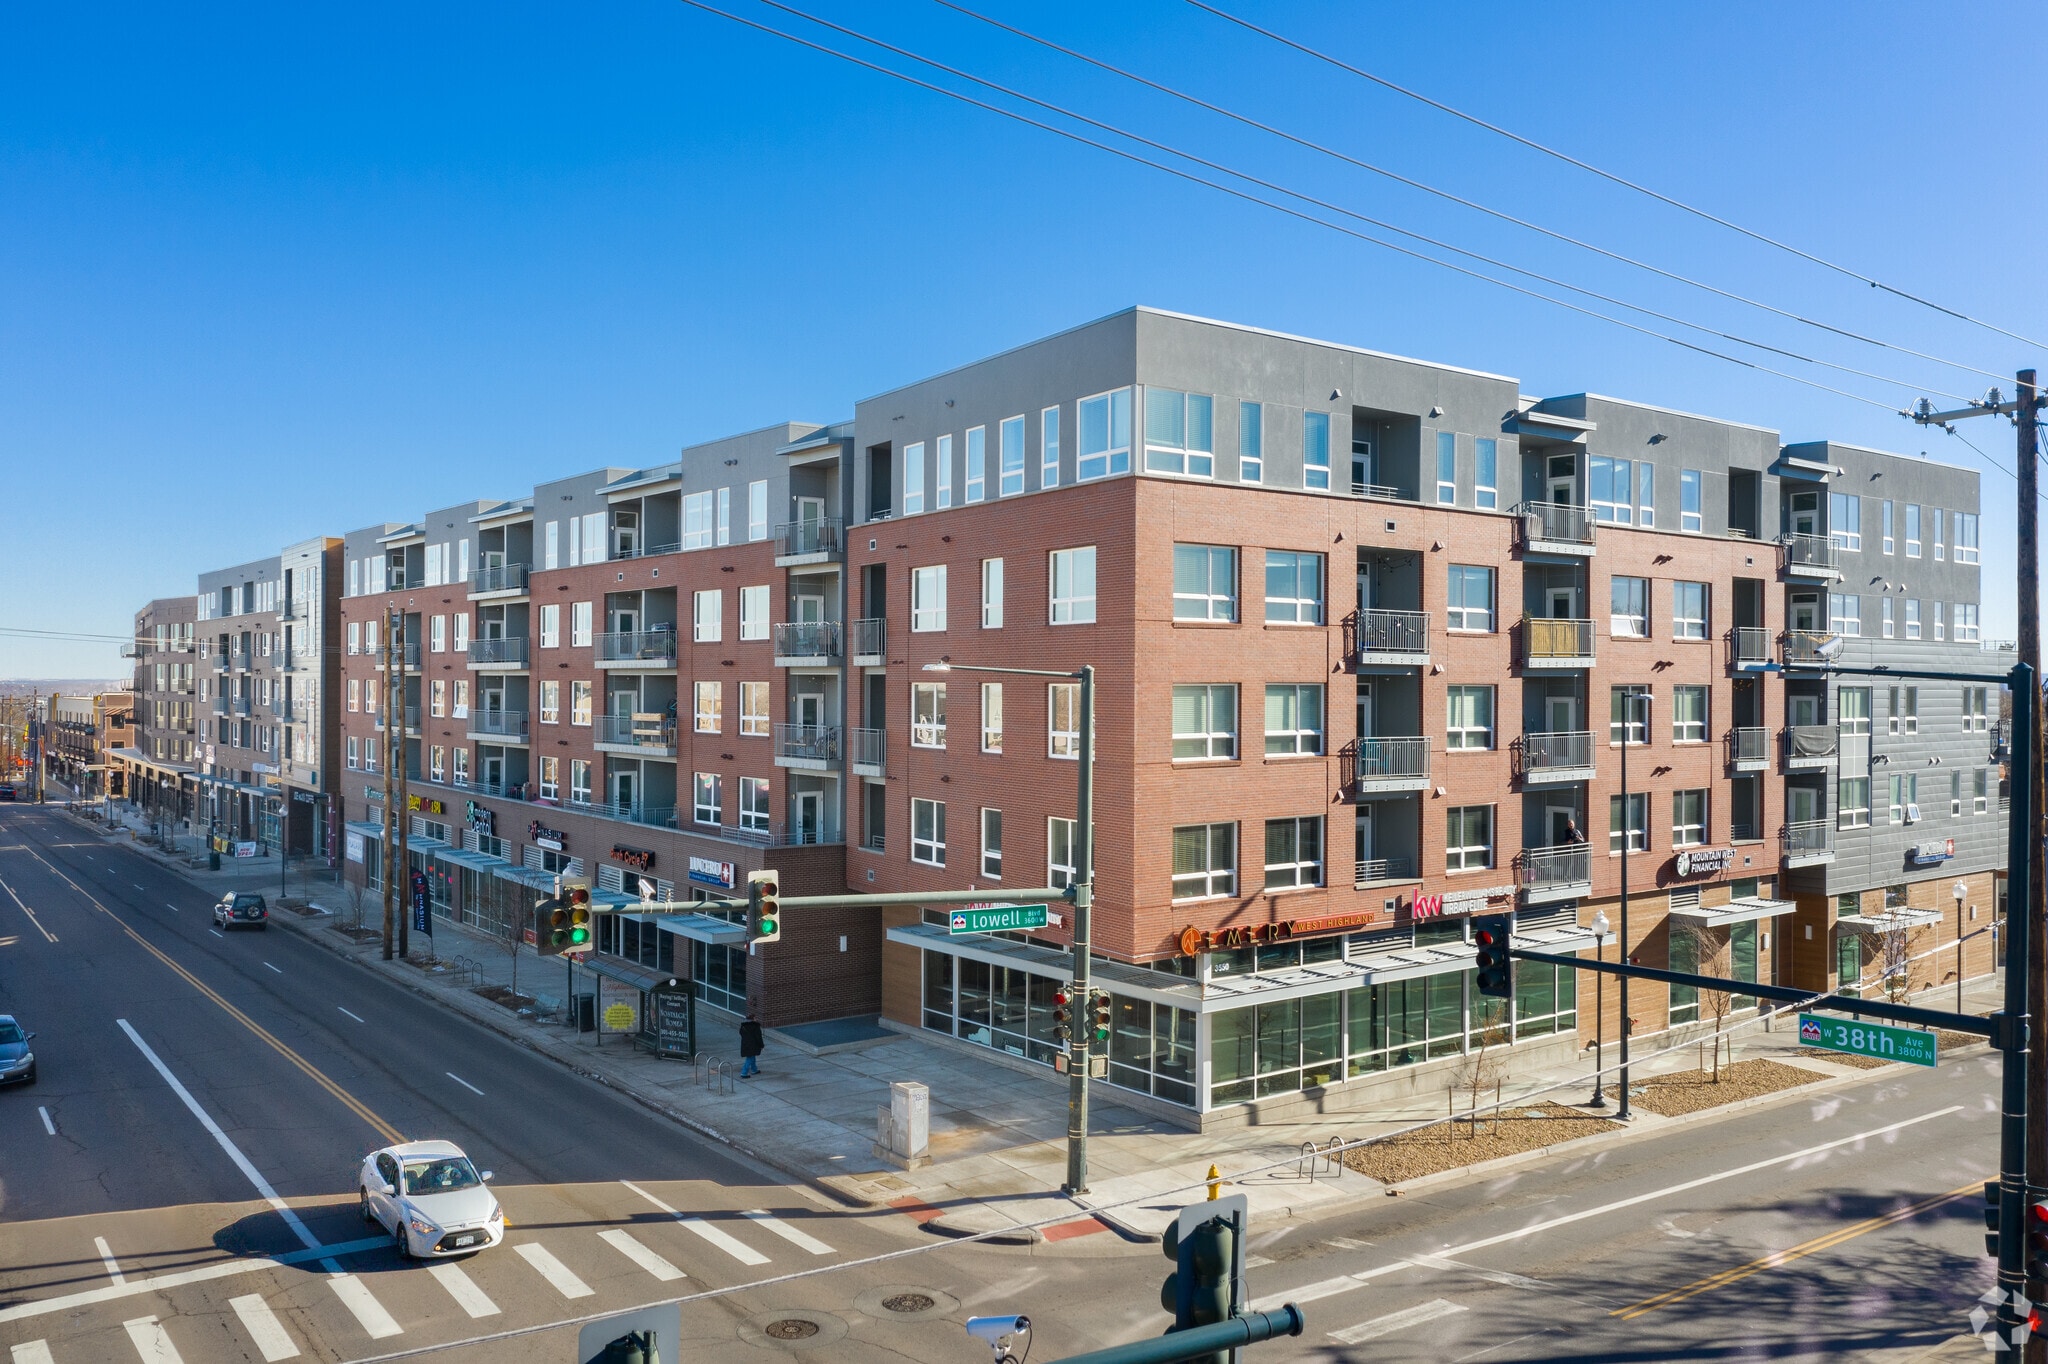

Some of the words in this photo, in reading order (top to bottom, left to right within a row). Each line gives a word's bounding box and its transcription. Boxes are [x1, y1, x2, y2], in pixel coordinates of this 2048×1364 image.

[471, 817, 492, 836] Dental
[624, 851, 640, 866] Cycle
[1691, 851, 1721, 862] MOUNTAIN
[1722, 849, 1737, 858] WEST
[1691, 861, 1721, 873] FINANCIAL
[1722, 860, 1731, 869] INC
[1412, 888, 1443, 919] kw
[1442, 901, 1468, 915] URBAN
[1470, 898, 1488, 911] ELITE
[973, 910, 1020, 929] Lowell
[1207, 921, 1295, 948] EMERY
[1297, 920, 1323, 931] WEST
[1327, 913, 1374, 927] HIGHLAND
[1214, 963, 1229, 972] 3550
[1824, 1029, 1832, 1038] W
[1835, 1026, 1894, 1054] 38th
[1906, 1037, 1924, 1048] Ave
[1898, 1046, 1922, 1058] 3800
[1926, 1051, 1932, 1059] N
